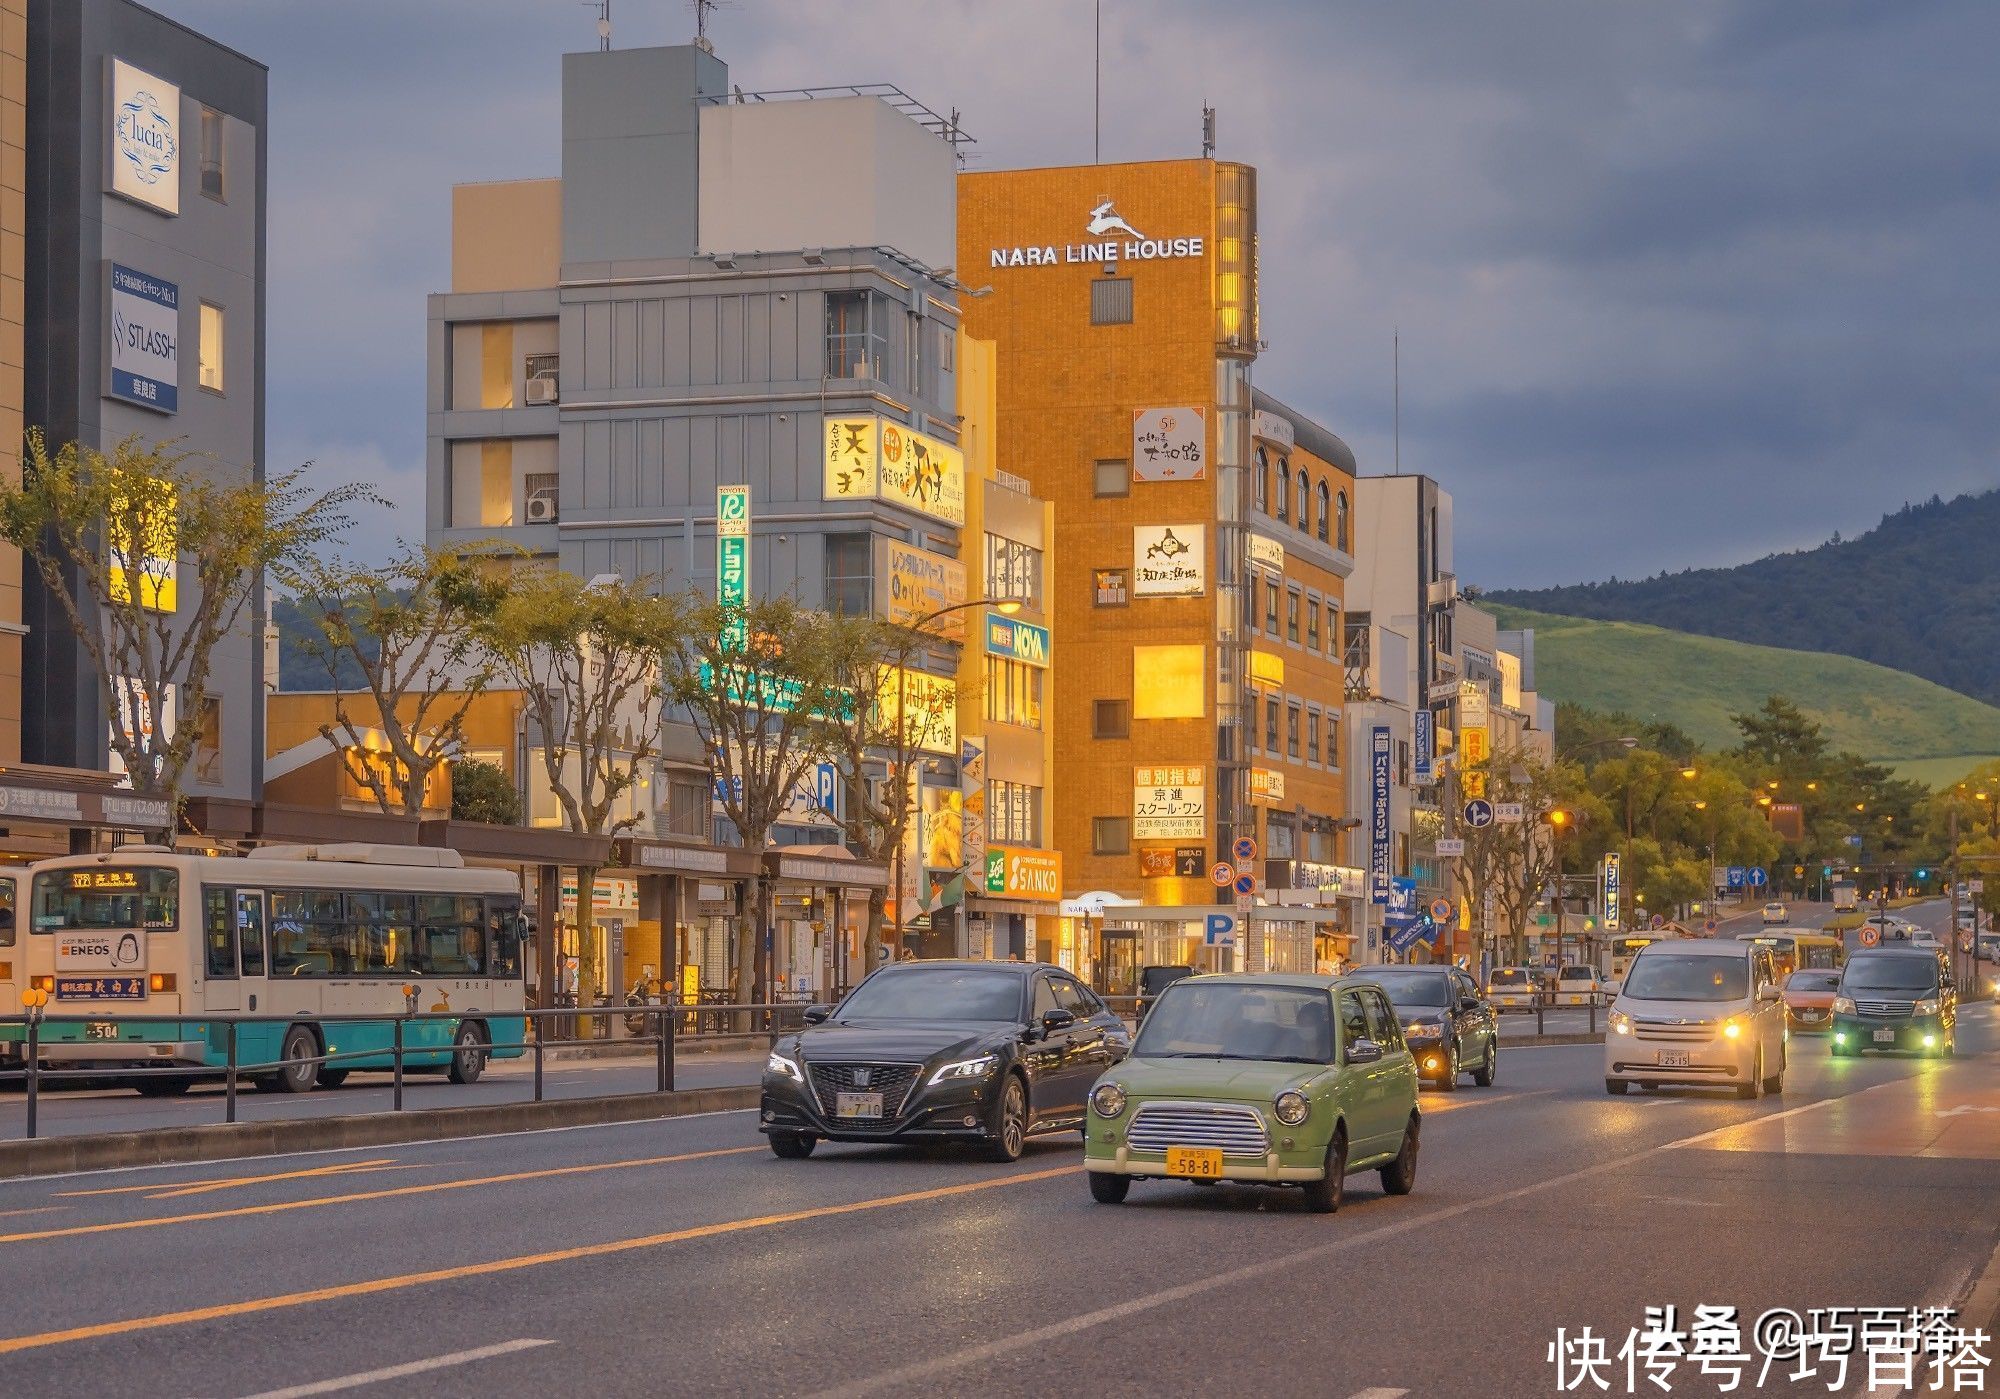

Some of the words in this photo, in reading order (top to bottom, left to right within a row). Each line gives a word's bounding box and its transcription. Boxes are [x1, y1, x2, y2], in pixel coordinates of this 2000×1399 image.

[131, 114, 163, 151] lucia
[991, 247, 1058, 268] NARA
[1066, 243, 1118, 263] LINE
[1125, 238, 1204, 260] HOUSE
[128, 323, 177, 361] STLASSH
[133, 378, 157, 400] 奈良店
[1013, 623, 1044, 660] NOVA
[821, 771, 832, 808] P
[1136, 768, 1202, 786] 個別指導
[1153, 787, 1183, 801] 京進
[1137, 802, 1202, 815] スクール・ワン
[1019, 867, 1057, 894] SANKO
[1207, 914, 1234, 944] P
[71, 945, 110, 955] ENEOS
[1179, 1158, 1217, 1175] 58-81
